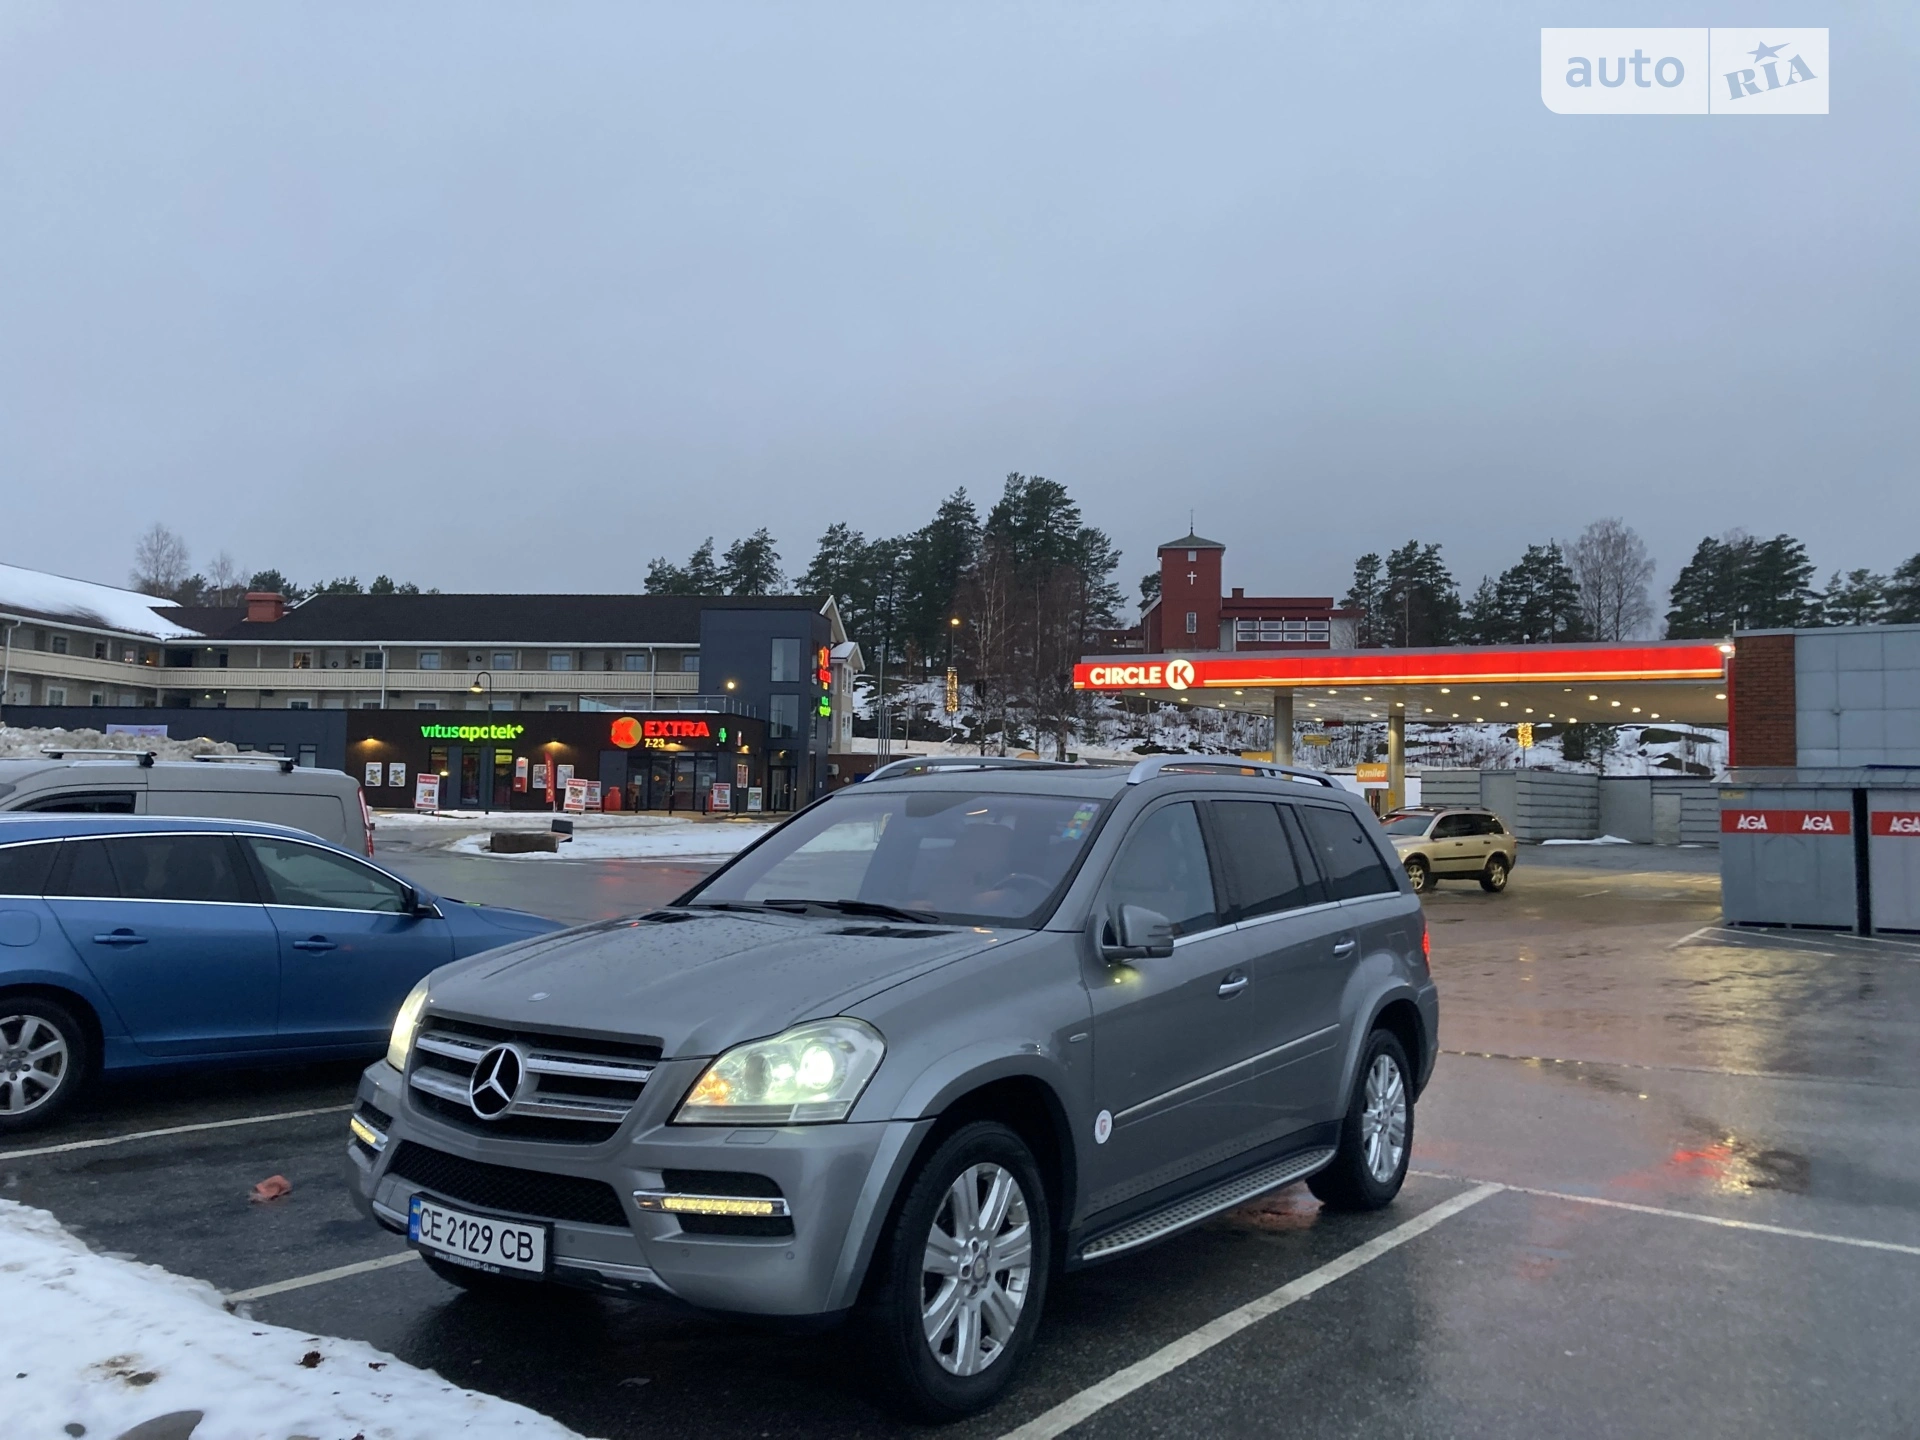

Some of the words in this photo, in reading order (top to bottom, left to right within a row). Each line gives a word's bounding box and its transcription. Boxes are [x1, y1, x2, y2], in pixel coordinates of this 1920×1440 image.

[1089, 666, 1162, 686] CIRCLE
[1171, 664, 1194, 690] K
[644, 720, 711, 737] EXTRA
[644, 738, 665, 748] 7-23
[1364, 768, 1386, 778] miles
[1736, 813, 1769, 830] AGA
[1802, 814, 1834, 831] AGA
[1889, 815, 1920, 833] AGA
[420, 1207, 443, 1243] CE
[446, 1216, 494, 1255] 2129
[499, 1229, 534, 1263] CB
